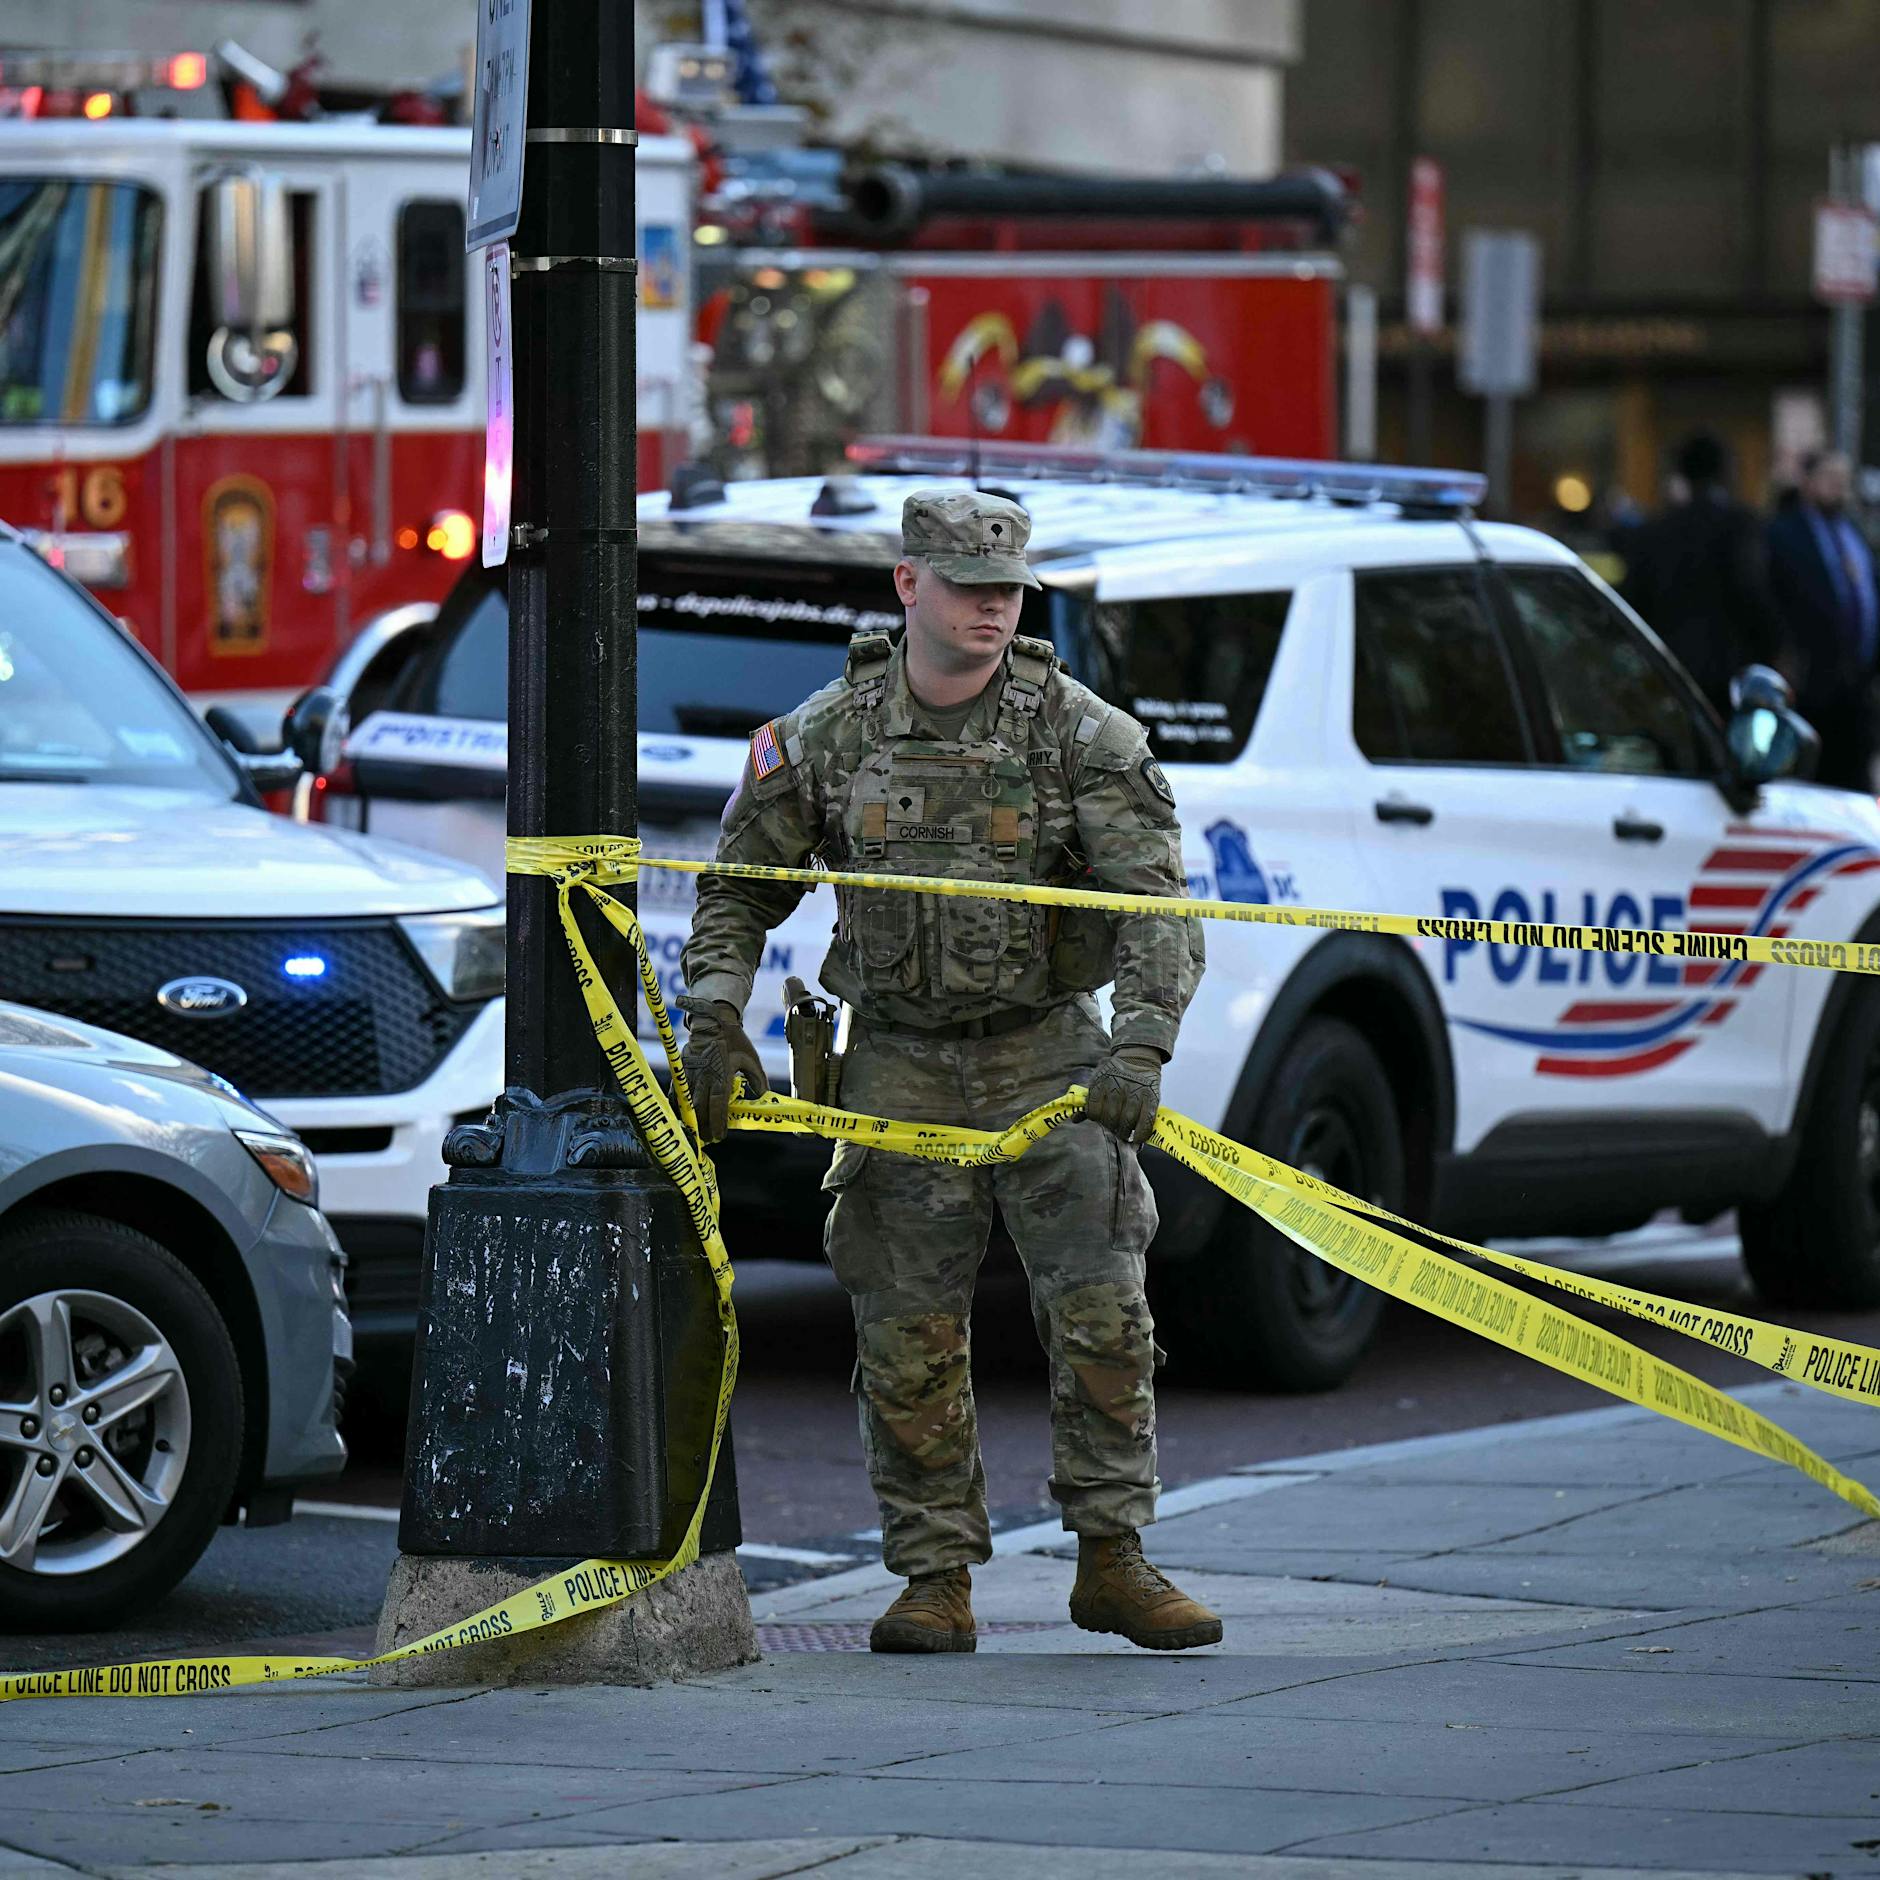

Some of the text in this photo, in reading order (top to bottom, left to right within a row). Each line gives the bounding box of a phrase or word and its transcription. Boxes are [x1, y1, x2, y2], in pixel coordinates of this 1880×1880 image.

[54, 466, 128, 529] 16
[1028, 751, 1052, 766] RMY
[899, 826, 954, 840] CORNISH
[1417, 918, 1491, 943] CROSS
[1440, 885, 1685, 988] POLICE
[1502, 922, 1543, 947] NOT
[1591, 927, 1665, 955] SCENE
[1673, 933, 1748, 961] CRIME
[180, 984, 228, 1009] Ford
[606, 1040, 649, 1097] POLICE
[632, 1093, 669, 1133] LINE
[650, 1127, 681, 1159] DO
[664, 1152, 698, 1187] NOT
[686, 1185, 717, 1242] CROSS
[1700, 1318, 1754, 1356] CROSS
[1802, 1345, 1880, 1397] POLICE LIN
[564, 1566, 624, 1607] POLICE
[459, 1610, 513, 1645] CROSS
[68, 1667, 104, 1694] LINE
[109, 1666, 132, 1694] DO
[138, 1665, 171, 1693] NOT
[176, 1664, 231, 1691] CROSS
